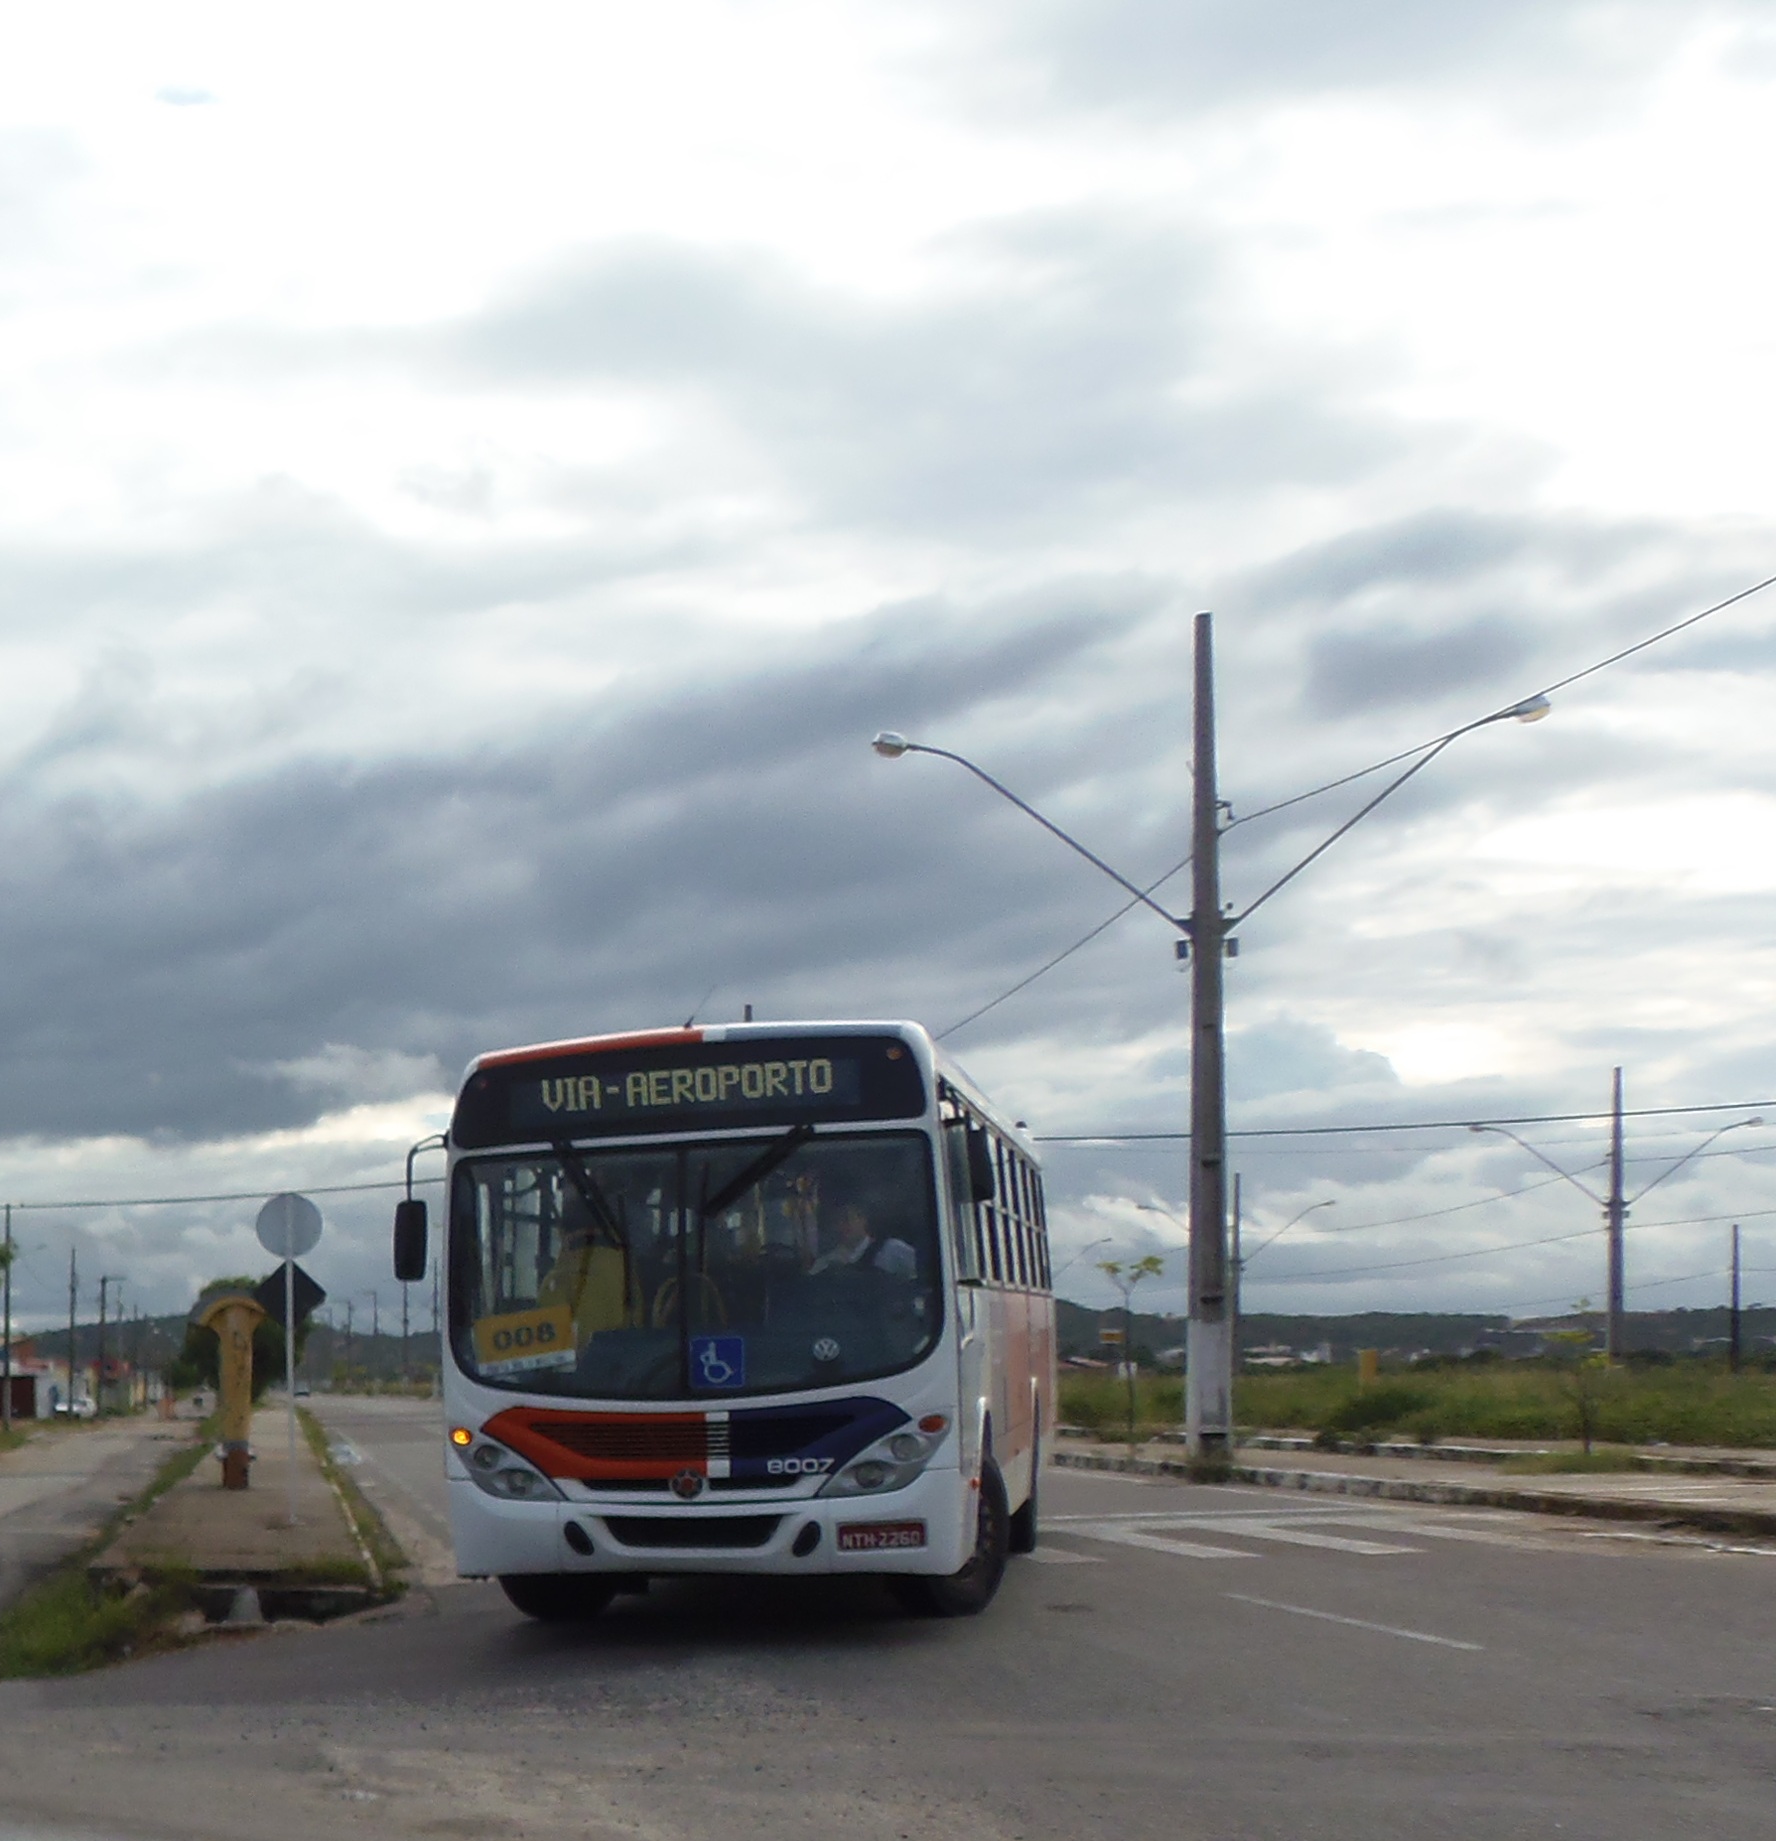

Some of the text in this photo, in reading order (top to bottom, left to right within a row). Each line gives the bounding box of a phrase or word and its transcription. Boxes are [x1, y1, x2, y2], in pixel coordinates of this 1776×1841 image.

[492, 1322, 556, 1352] 008
[767, 1457, 835, 1474] 8007
[842, 1531, 921, 1548] NTH-2260
